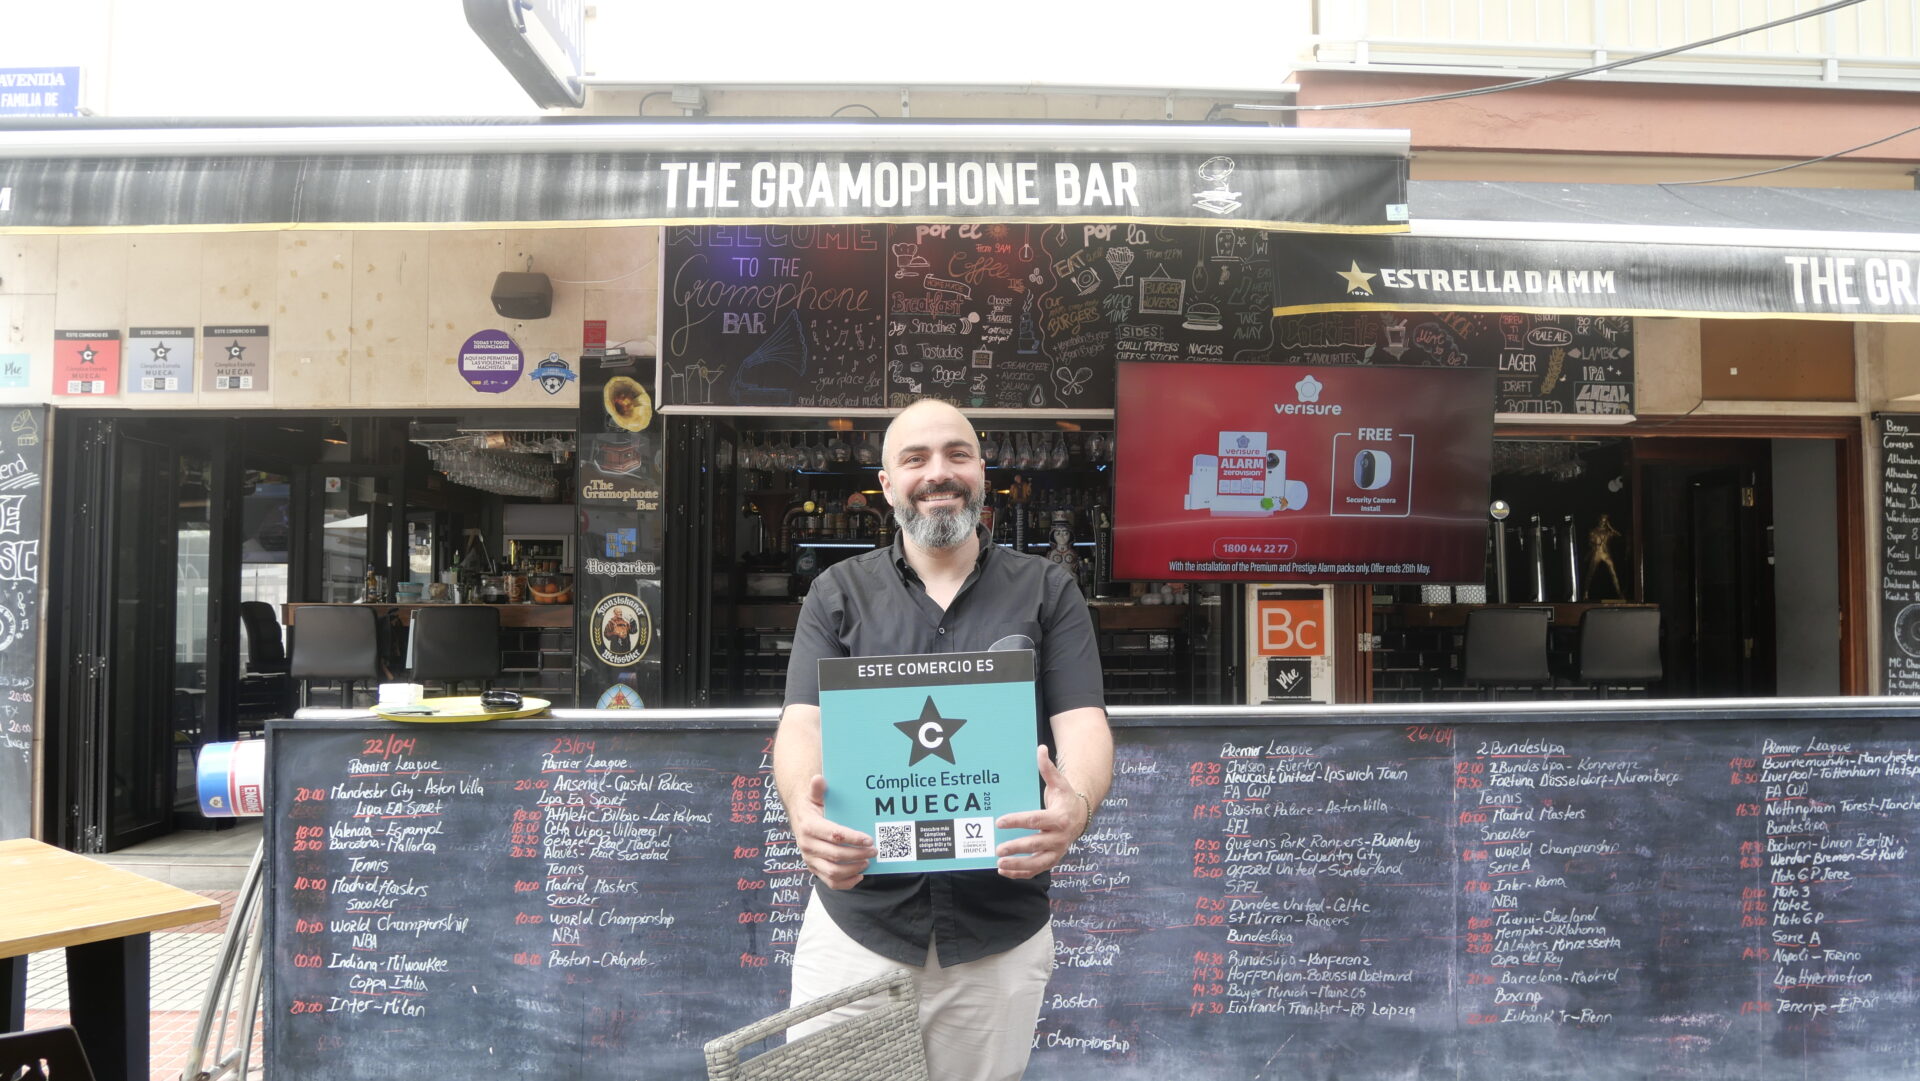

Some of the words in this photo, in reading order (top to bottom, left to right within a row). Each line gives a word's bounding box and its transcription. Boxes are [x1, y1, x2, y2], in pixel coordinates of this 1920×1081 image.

[1, 92, 41, 107] FAMILIA
[45, 92, 59, 106] DE
[661, 162, 736, 208] THE
[750, 161, 1039, 208] GRAMOPHONE
[1056, 162, 1140, 207] BAR
[1083, 224, 1117, 247] por
[1126, 224, 1149, 245] la
[732, 257, 759, 277] TO
[768, 258, 800, 277] THE
[948, 251, 1009, 285] Coffee
[1053, 250, 1084, 278] EAT
[1145, 281, 1181, 294] BURGER
[1785, 256, 1860, 305] THE
[671, 253, 872, 357] Gramophone
[891, 292, 965, 319] Breakfast
[722, 312, 767, 334] BAR
[1235, 312, 1262, 325] TAKE
[1123, 327, 1158, 337] SIDES
[1234, 326, 1263, 340] AWAY
[1553, 332, 1567, 342] ALE
[916, 343, 963, 360] Tostadas
[1117, 340, 1141, 351] CHILLI
[1143, 342, 1179, 351] POPPERS
[1188, 343, 1223, 355] NACHOS
[1499, 354, 1536, 372] LAGER
[932, 365, 967, 388] Bagel
[1583, 366, 1605, 381] IPA
[1503, 380, 1532, 392] DRAFT
[1274, 402, 1342, 416] verisure
[1504, 399, 1562, 413] BOTTLED
[1358, 428, 1393, 441] FREE
[1886, 420, 1908, 434] Beers
[1221, 458, 1264, 469] ALARM
[590, 480, 614, 490] The
[582, 485, 659, 502] Gramophone
[1346, 496, 1371, 504] Security
[636, 500, 658, 510] Bar
[1223, 544, 1247, 552] 1800
[1249, 544, 1261, 552] 44
[1264, 545, 1275, 553] 22
[1278, 545, 1288, 553] 77
[587, 558, 656, 575] Hoegaarden
[1169, 561, 1184, 571] With
[1185, 562, 1195, 571] the
[1196, 562, 1230, 571] installation
[1232, 562, 1238, 572] of
[1239, 562, 1249, 572] the
[1250, 562, 1277, 572] Premium
[1279, 562, 1291, 572] and
[1292, 562, 1316, 574] Prestige
[1318, 563, 1335, 573] Alarm
[1337, 563, 1354, 574] packs
[1356, 563, 1370, 574] only.
[1371, 564, 1385, 573] Offer
[1386, 564, 1400, 573] ends
[1402, 564, 1416, 573] 26th
[1417, 564, 1430, 574] May.
[597, 596, 645, 617] Franziskaner
[1262, 608, 1317, 650] Bc
[602, 649, 641, 664] Weissbier
[858, 664, 893, 677] ESTE
[898, 660, 972, 675] COMERCIO
[977, 659, 993, 672] ES
[918, 722, 944, 749] C
[1406, 727, 1451, 745] 26/04
[362, 734, 416, 759] 22/04
[551, 738, 596, 754] 23/04
[1807, 736, 1851, 758] League
[395, 755, 441, 780] League
[1190, 762, 1221, 774] 12:30
[295, 788, 326, 801] 20:00
[330, 783, 387, 800] Manchester
[391, 782, 414, 801] City
[425, 780, 455, 794] Aston
[460, 775, 484, 796] Villa
[514, 779, 549, 790] 20:00
[658, 773, 695, 794] Palace
[866, 773, 936, 792] Cómplice
[941, 770, 1000, 786] Estrella
[875, 792, 981, 816] MUECA
[1478, 789, 1522, 805] Tennis
[1540, 805, 1586, 820] Masters
[296, 826, 324, 839] 18:00
[348, 857, 389, 873] Tennis
[546, 862, 585, 876] Tennis
[294, 878, 327, 891] 10:00
[546, 876, 586, 892] Madrid
[1773, 887, 1798, 898] Moto
[1492, 896, 1518, 908] NBA
[295, 921, 324, 933] 10:00
[377, 913, 470, 938] Championship
[353, 933, 377, 948] NBA
[552, 930, 580, 944] NBA
[1810, 932, 1821, 944] A
[349, 975, 387, 995] Coppa
[388, 975, 428, 991] Italia
[290, 1002, 324, 1014] 20:00
[1047, 1030, 1129, 1053] Championship
